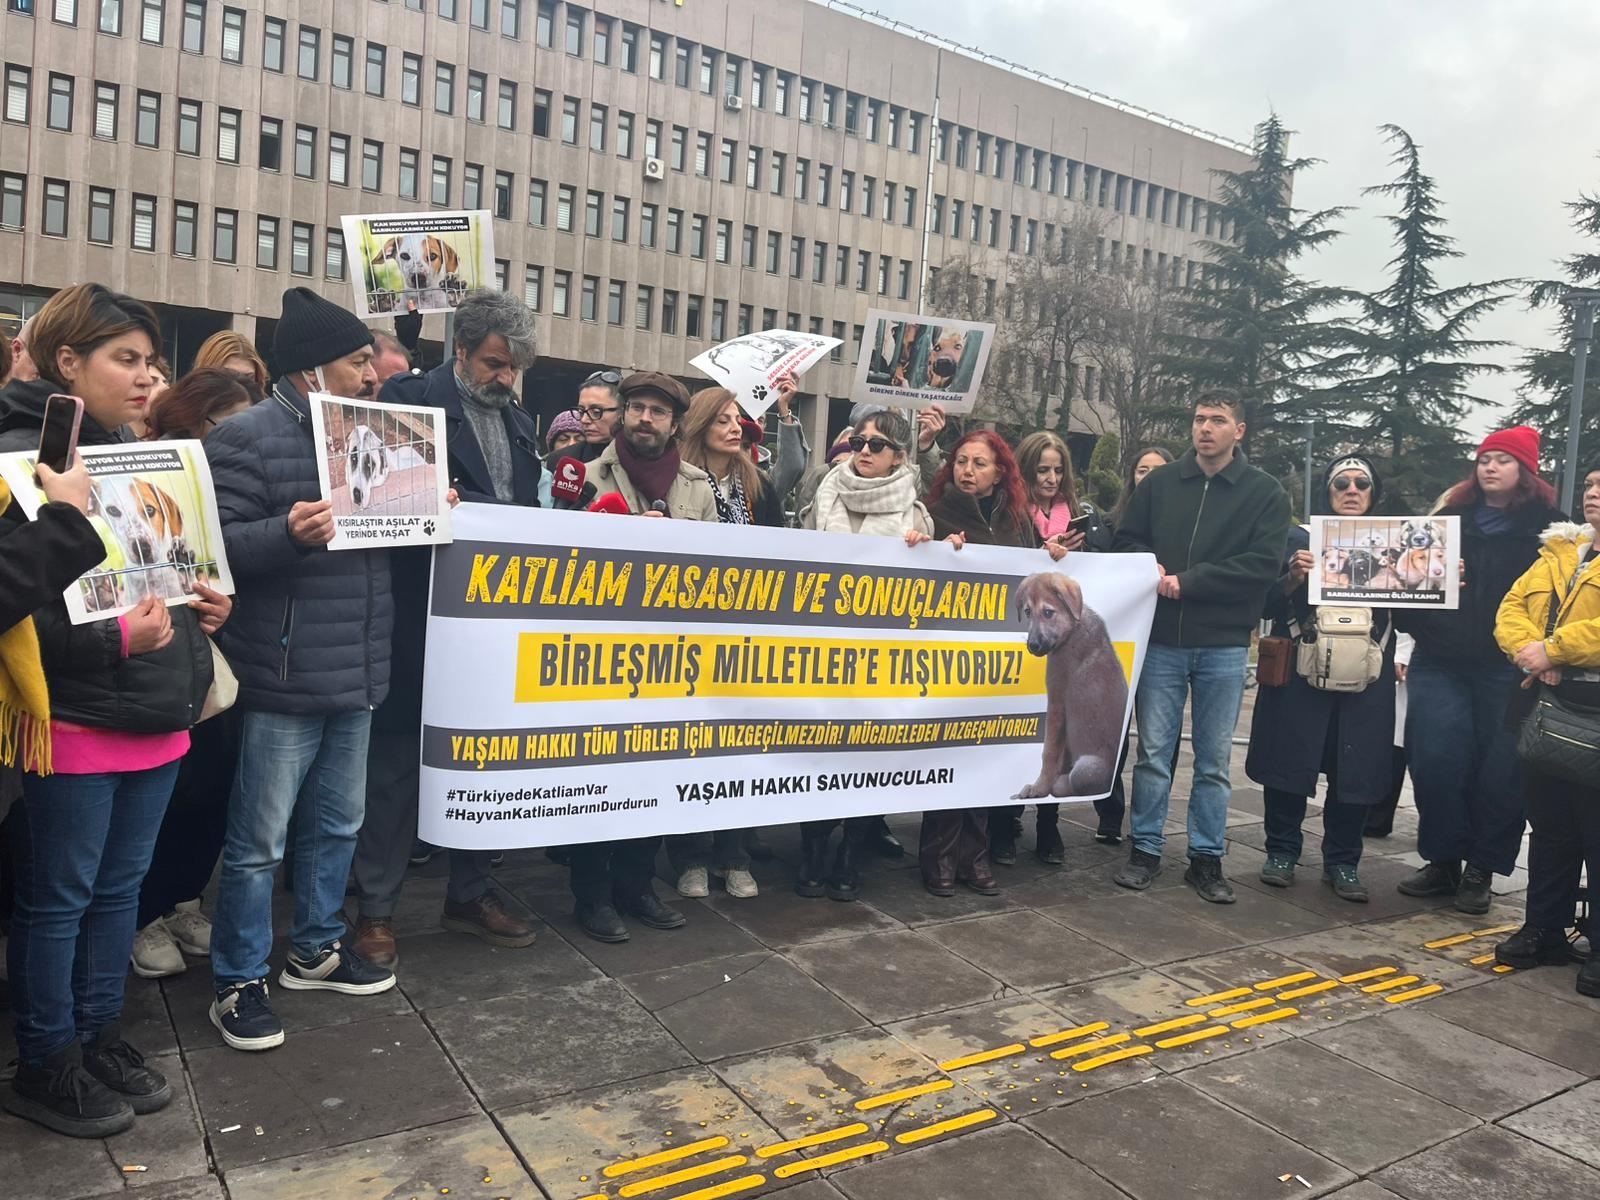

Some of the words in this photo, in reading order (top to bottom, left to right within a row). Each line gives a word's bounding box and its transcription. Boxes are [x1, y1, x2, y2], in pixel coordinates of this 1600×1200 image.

[895, 390, 919, 398] DİRENE
[557, 480, 578, 490] anka
[338, 518, 383, 528] KISIRLAŞTIR
[386, 518, 420, 528] AŞILAT
[346, 528, 378, 538] YERİNDE
[380, 529, 410, 539] YAŞAT
[466, 548, 632, 606] KATLİAM
[642, 564, 785, 612] YASASINI
[794, 571, 831, 614] VE
[835, 574, 1008, 628] SONUÇLARINI
[540, 634, 702, 698] BİRLEŞMİŞ
[889, 648, 1023, 697] TAŞIYORUZ!
[452, 735, 518, 768] YAŞAM
[526, 733, 576, 760] HAKKI
[583, 726, 617, 756] TÜM
[623, 724, 678, 753] TÜRLER
[684, 721, 713, 756] İÇİN
[719, 720, 844, 752] VAZGEÇİLMEZDİR!
[847, 719, 940, 745] MÜCADELEDEN
[943, 716, 1038, 744] VAZGEÇMİYORUZ!
[446, 783, 608, 804] #TürkiyedeKatliamVar
[676, 780, 744, 805] YAŞAM
[751, 774, 811, 797] HAKKI
[817, 768, 954, 791] SAVUNUCULARI
[445, 797, 658, 823] #HayvanKatliamlarınıDurdurun
